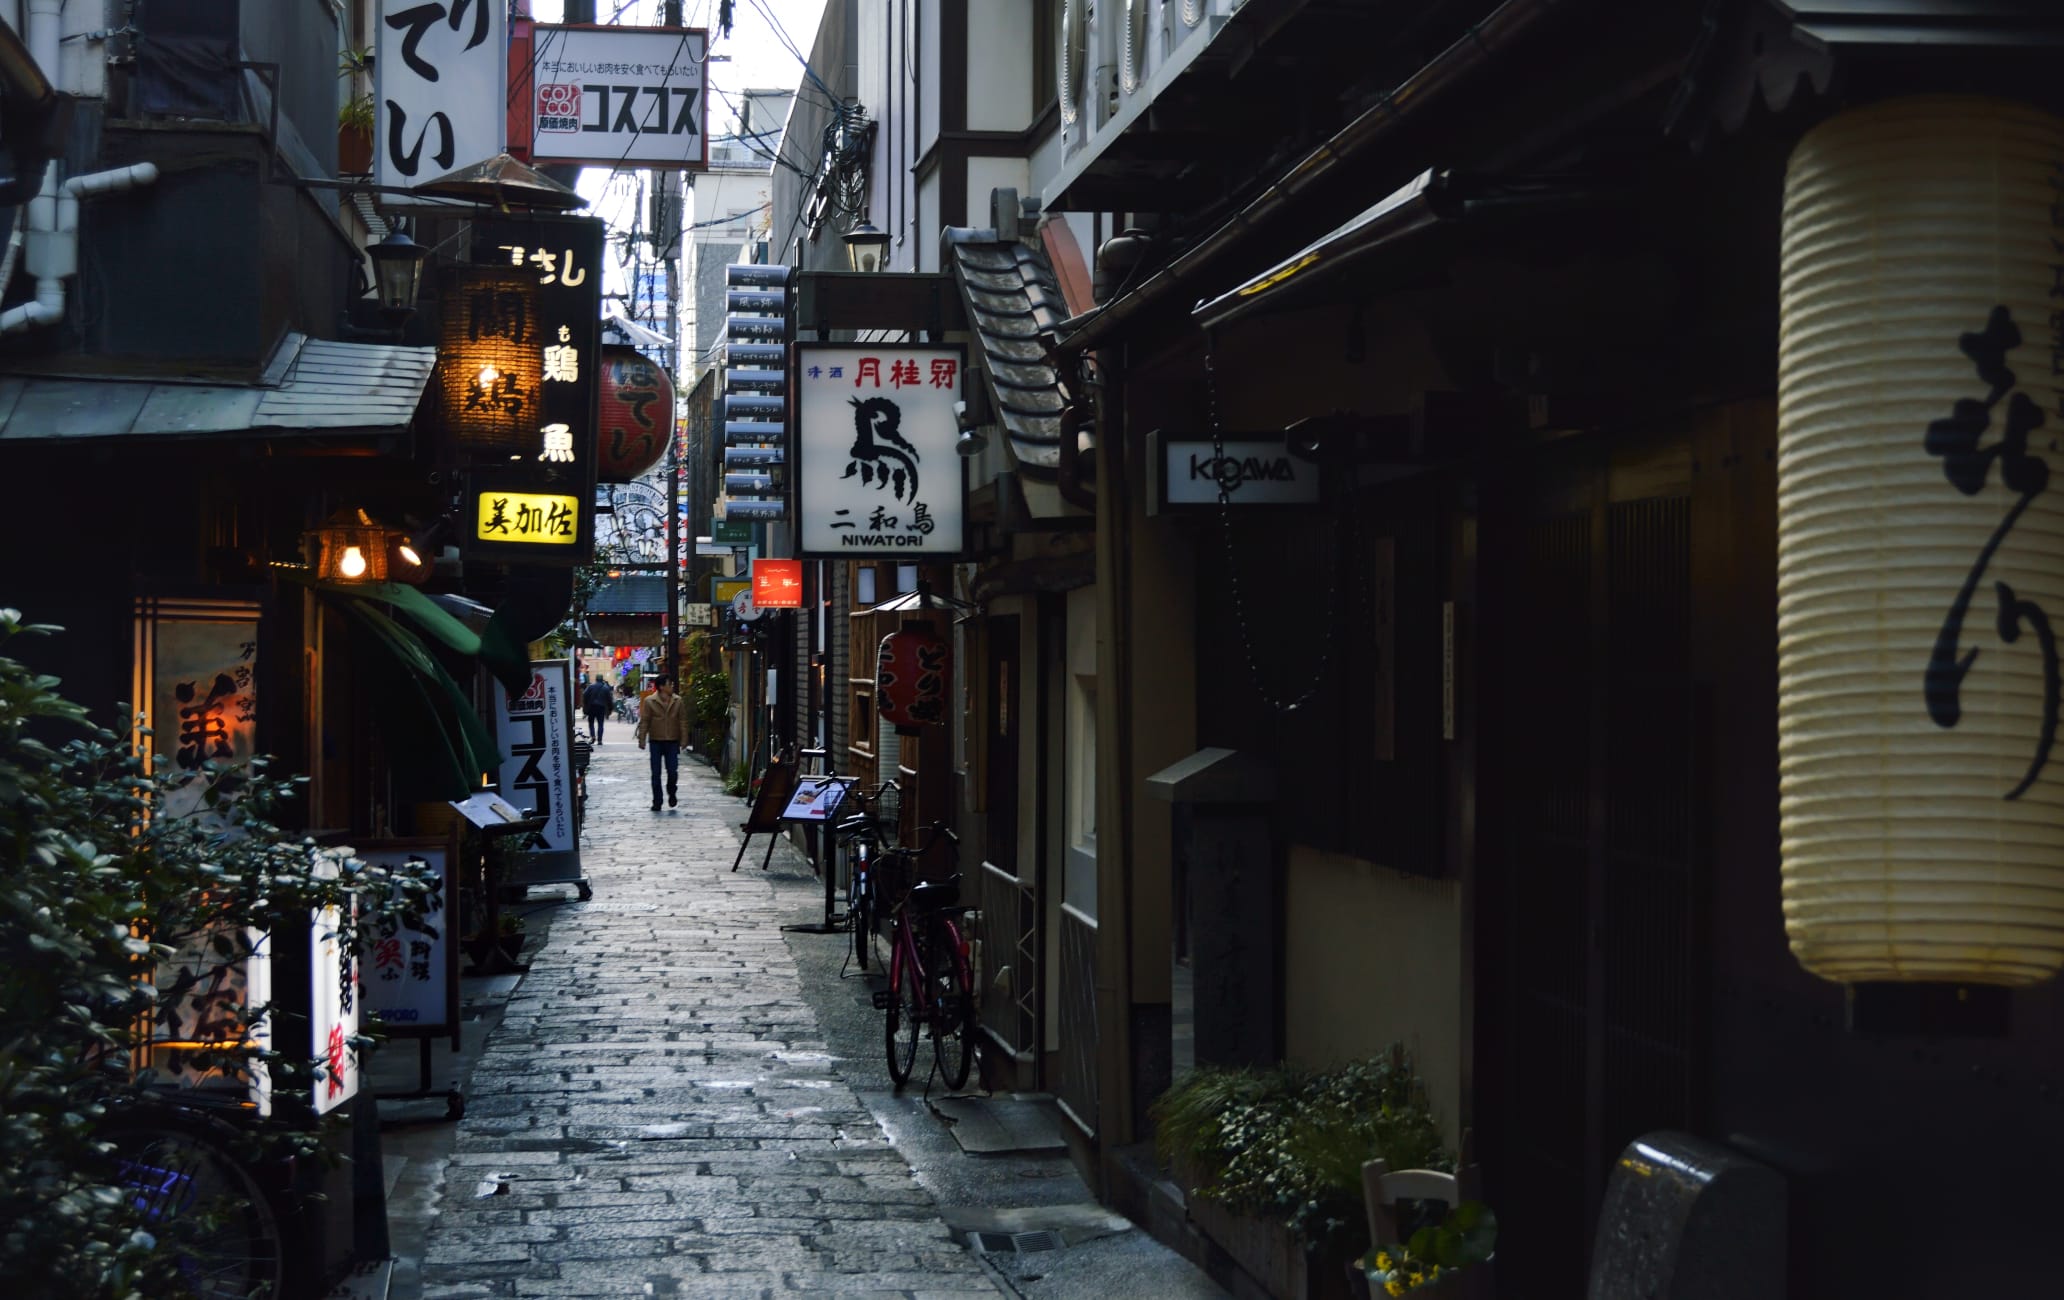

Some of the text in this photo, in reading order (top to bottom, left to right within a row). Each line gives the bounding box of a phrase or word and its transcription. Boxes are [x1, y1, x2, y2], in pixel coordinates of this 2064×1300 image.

[582, 85, 700, 135] コスコス
[807, 357, 958, 389] 清酒 月桂冠
[483, 497, 574, 537] 美加佐
[830, 501, 935, 536] 二和鳥
[842, 534, 923, 547] NIWATORI
